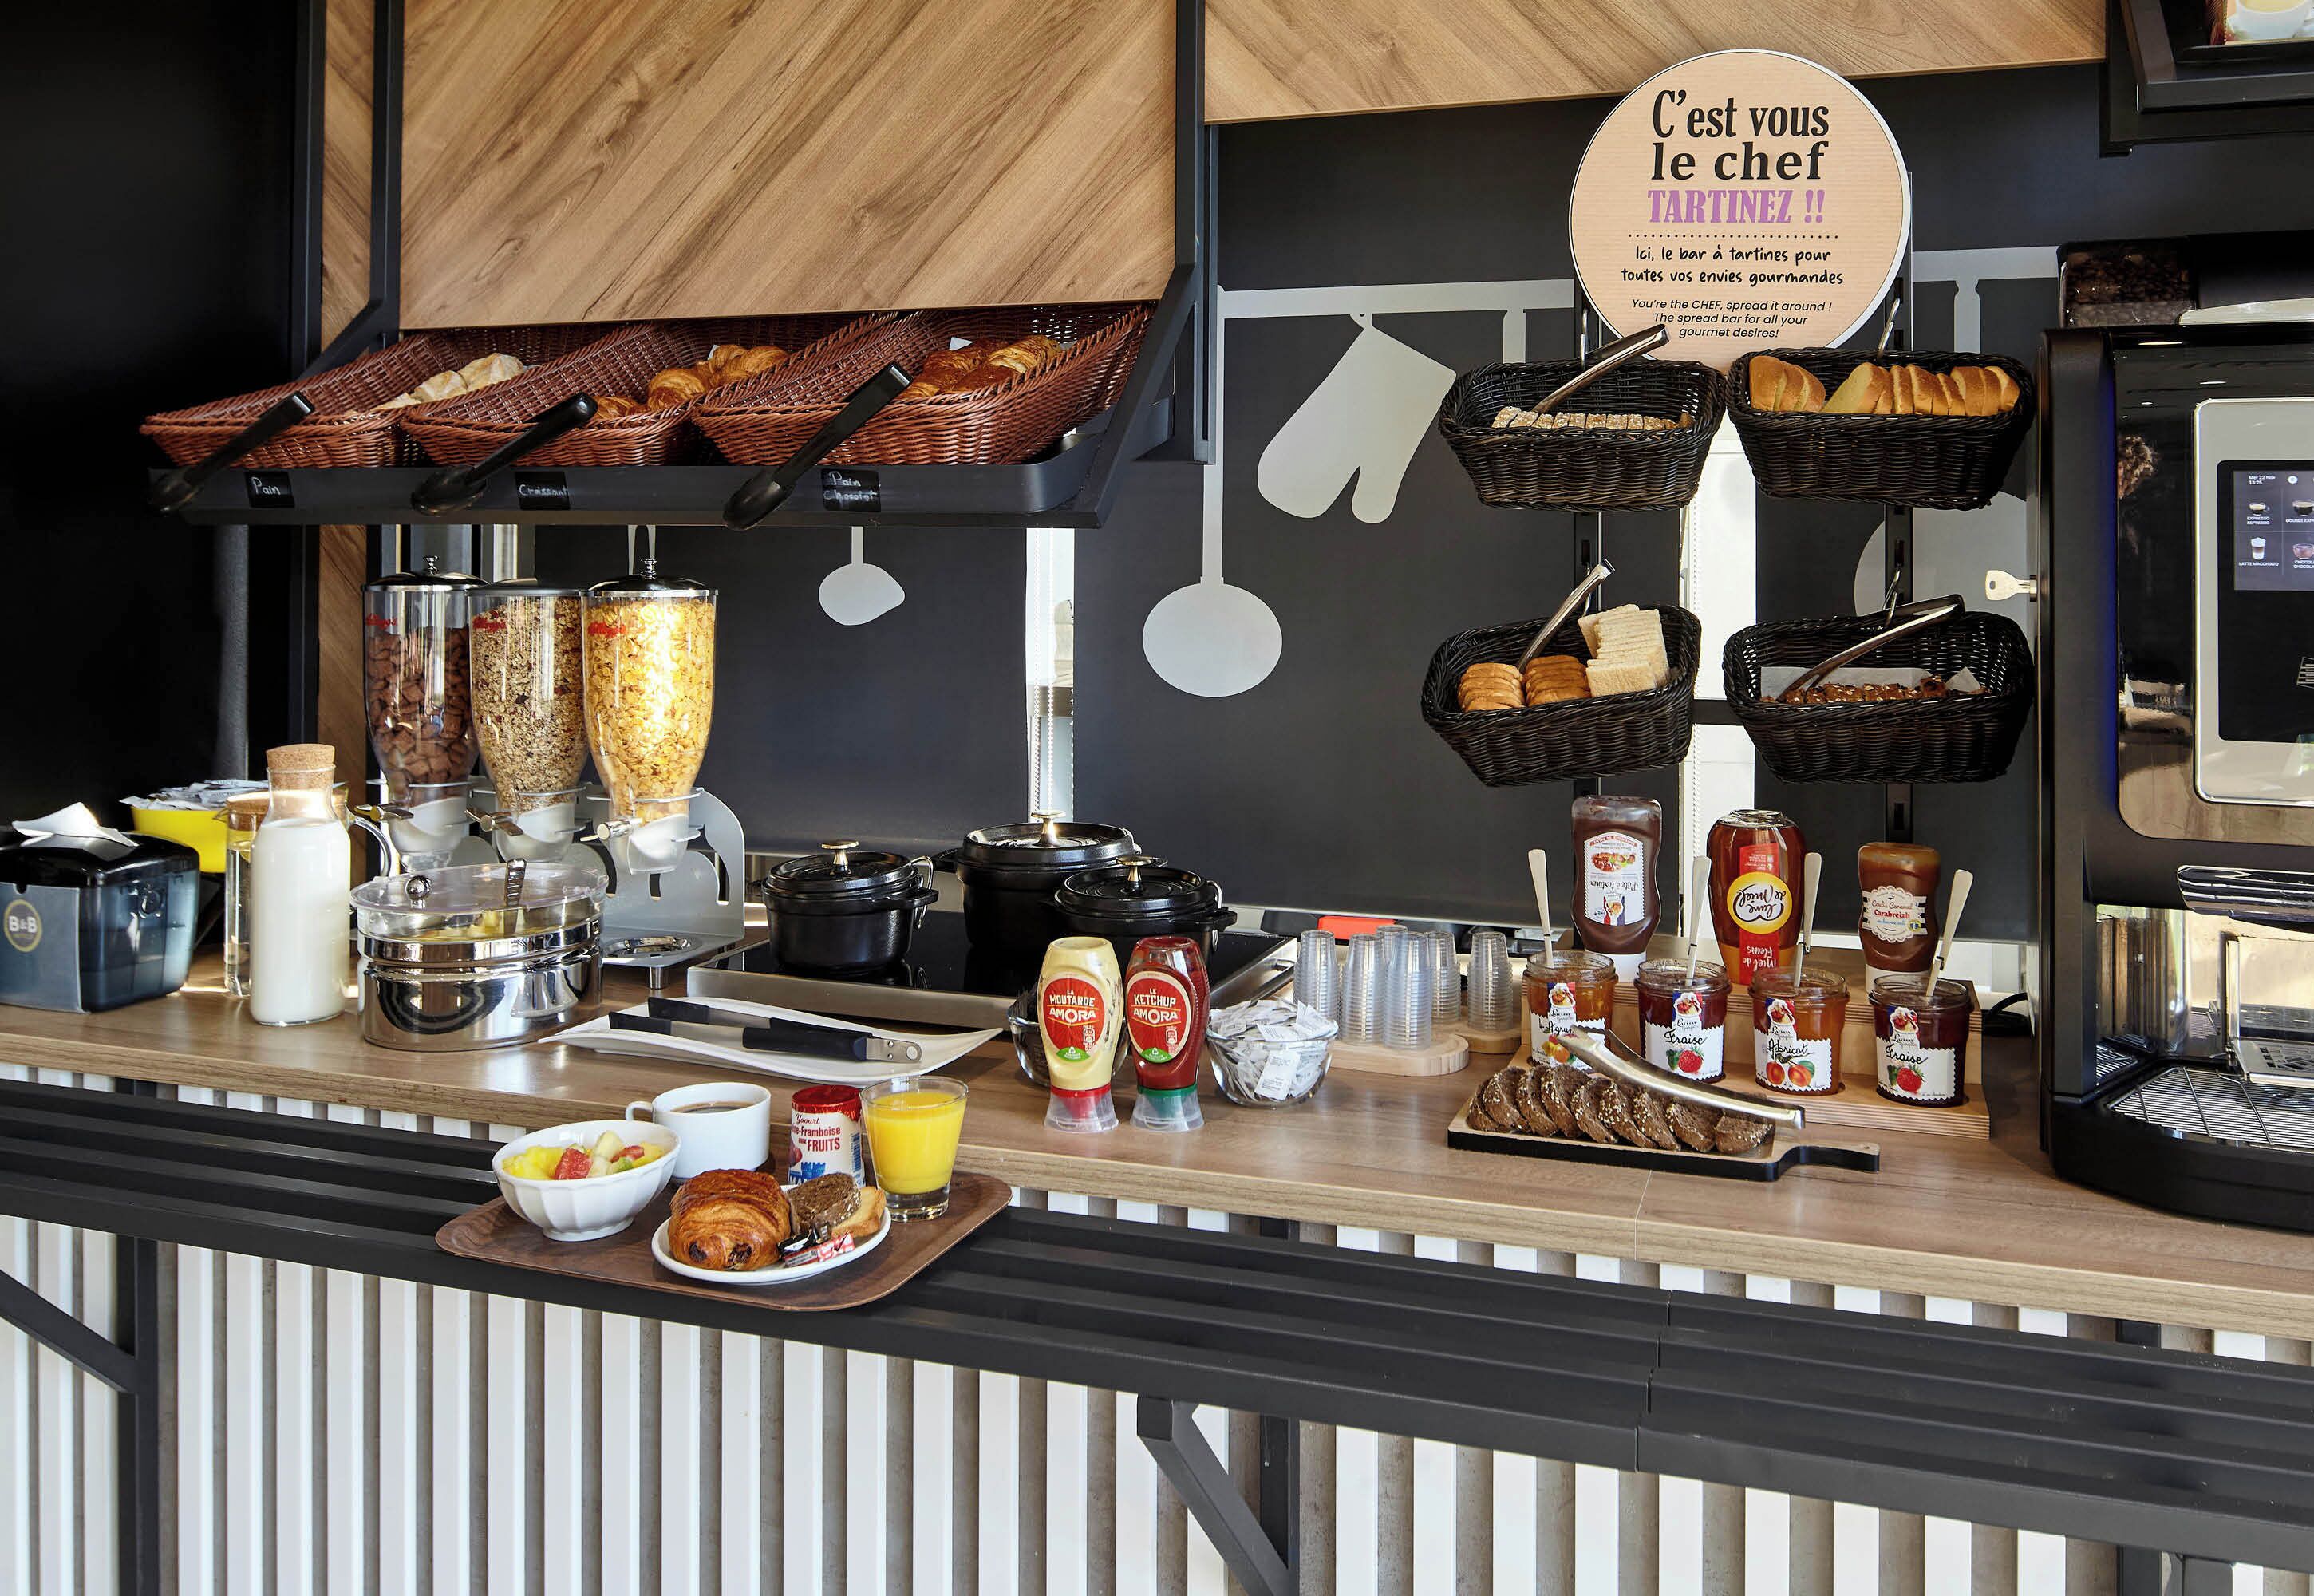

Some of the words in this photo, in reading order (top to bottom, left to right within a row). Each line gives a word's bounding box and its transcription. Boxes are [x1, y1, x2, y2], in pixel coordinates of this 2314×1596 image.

[1653, 89, 1738, 138] C’est
[1748, 105, 1830, 137] vous
[1651, 142, 1696, 180] le
[1714, 140, 1829, 180] chef
[1647, 189, 1794, 223] TARTINEZ
[1804, 189, 1826, 223] !!
[1636, 245, 1655, 262] Ici,
[1661, 246, 1673, 261] le
[1679, 247, 1707, 260] bar
[1712, 244, 1723, 260] à
[1728, 247, 1788, 262] tartines
[1795, 250, 1831, 267] pour
[1621, 267, 1664, 282] toutes
[1669, 271, 1692, 282] vos
[1699, 269, 1743, 283] envies
[1748, 269, 1843, 287] gourmandes
[1632, 298, 1668, 309] You’re
[1670, 299, 1689, 309] the
[1692, 300, 1723, 311] CHEF,
[1726, 301, 1768, 312] spread
[1771, 301, 1779, 310] it
[1781, 302, 1826, 311] around
[1654, 312, 1675, 322] The
[1677, 314, 1720, 325] spread
[1721, 314, 1742, 323] bar
[1744, 314, 1761, 324] for
[1763, 314, 1779, 324] all
[1780, 316, 1808, 327] your
[1678, 327, 1730, 338] gourmet
[1732, 327, 1779, 338] desires!
[251, 476, 281, 496] Pain
[828, 471, 861, 487] Pain
[9, 915, 38, 933] B&B
[1743, 958, 1752, 968] de
[1753, 958, 1777, 972] Miel
[1048, 994, 1096, 1007] MOUTARDE
[1133, 994, 1177, 1008] KETCHUP
[1048, 1007, 1096, 1024] AMORA
[1133, 1007, 1179, 1024] AMORA
[1664, 1027, 1708, 1045] Fraise
[1766, 1037, 1809, 1060] Abricot
[1885, 1043, 1929, 1065] Fraise
[796, 1113, 820, 1124] Yaourt
[807, 1137, 841, 1152] FRUITS
